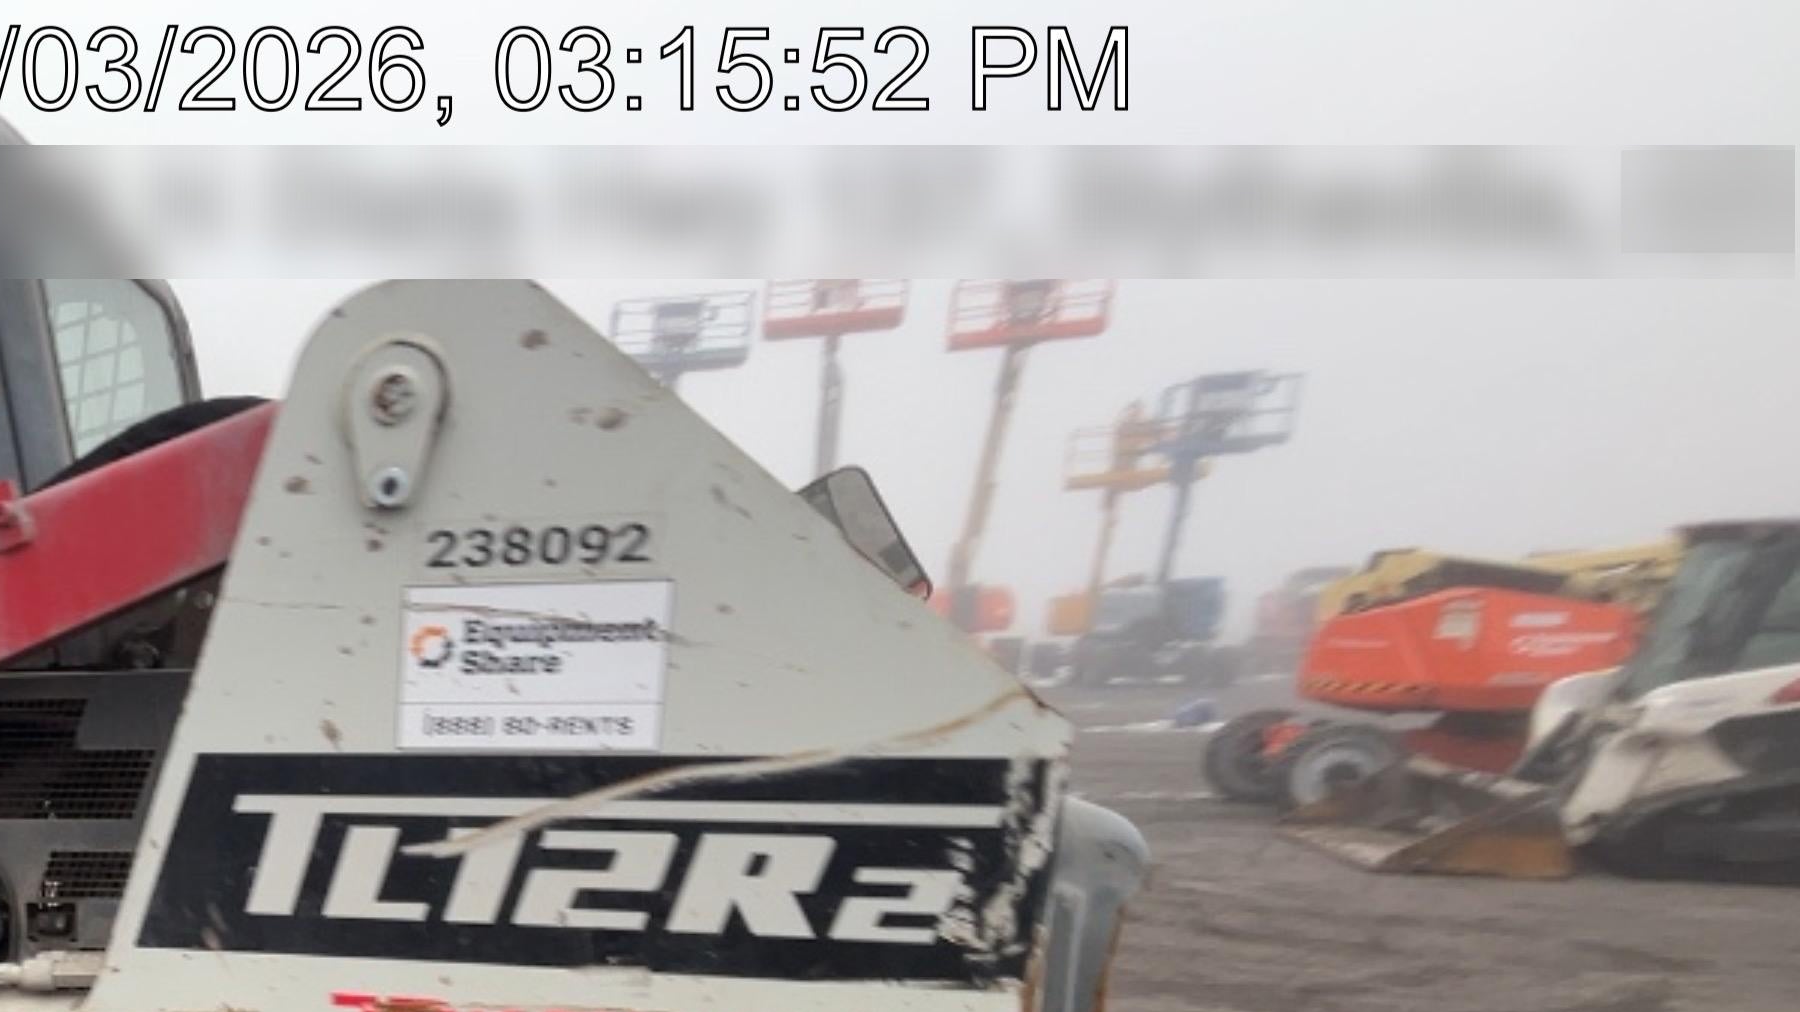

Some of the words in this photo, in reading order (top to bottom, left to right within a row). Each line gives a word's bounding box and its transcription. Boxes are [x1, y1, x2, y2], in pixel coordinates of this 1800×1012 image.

[425, 523, 652, 568] 238092
[461, 617, 659, 649] Equipment
[459, 650, 563, 675] Share
